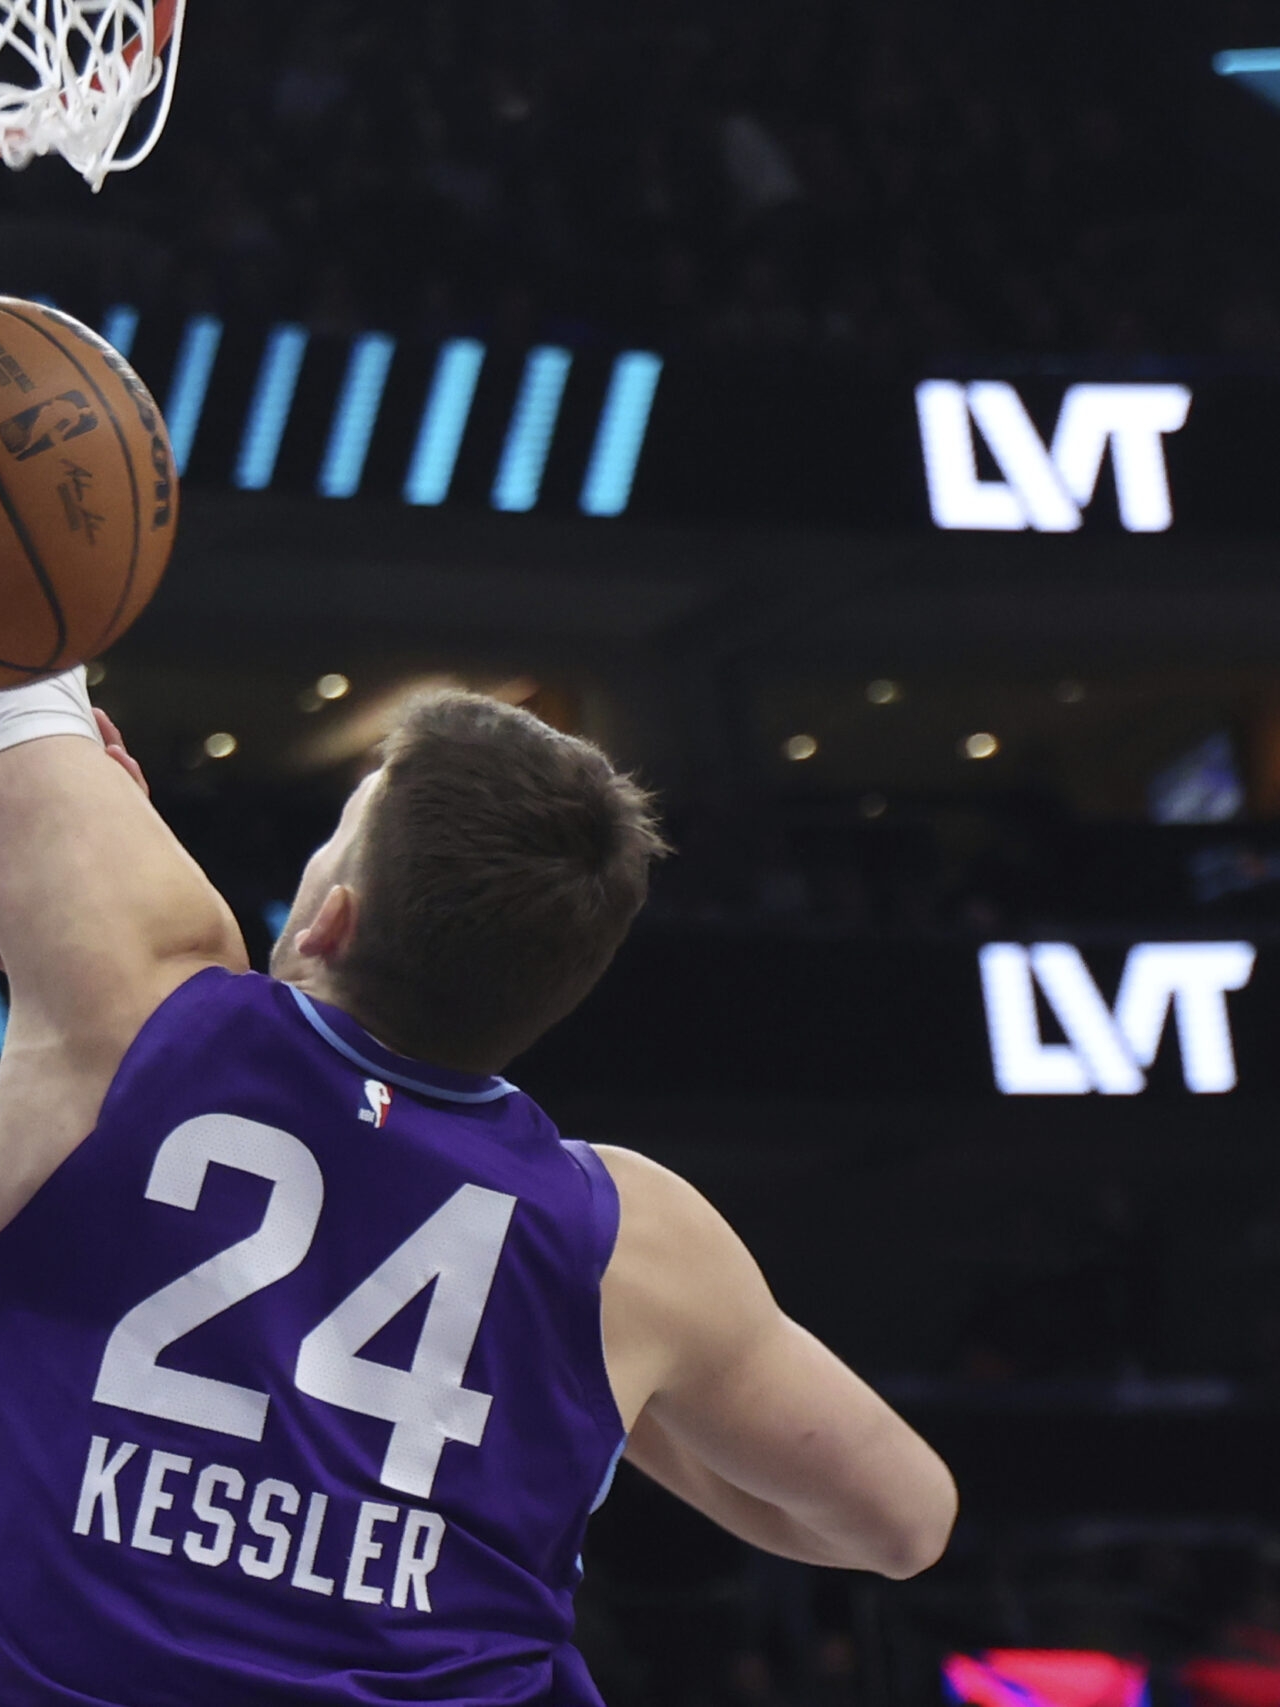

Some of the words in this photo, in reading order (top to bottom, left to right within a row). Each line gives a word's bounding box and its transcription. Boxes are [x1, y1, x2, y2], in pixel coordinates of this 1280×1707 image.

[915, 379, 1193, 533] LVT
[979, 941, 1256, 1096] LVT
[92, 1113, 519, 1500] 24
[73, 1435, 447, 1613] KESSLER
